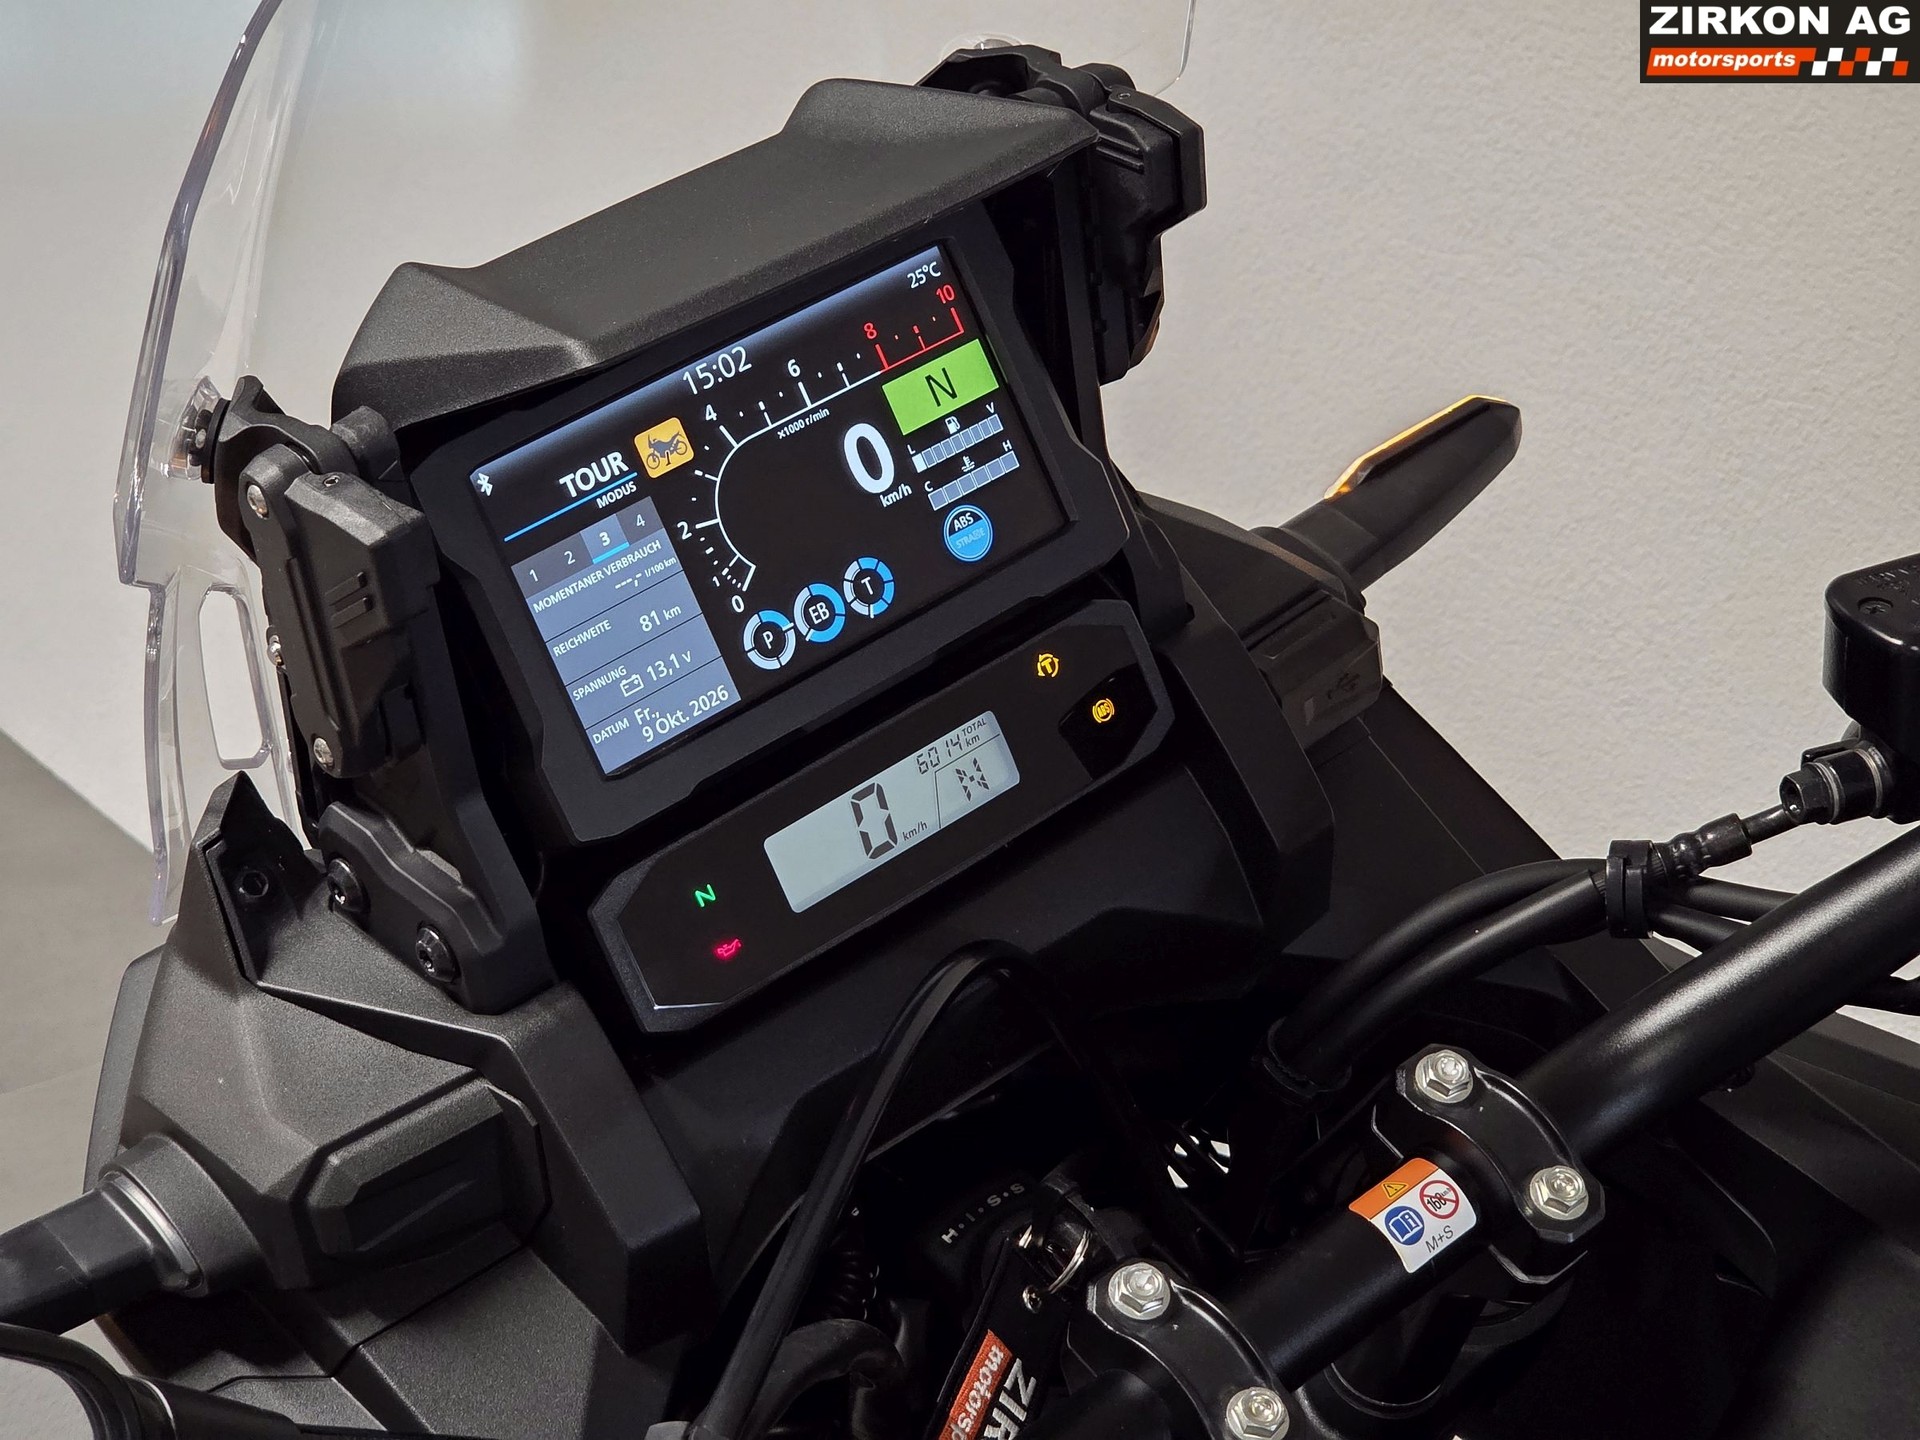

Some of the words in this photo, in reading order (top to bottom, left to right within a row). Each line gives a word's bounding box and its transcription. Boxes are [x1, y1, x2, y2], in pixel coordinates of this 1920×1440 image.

[907, 261, 941, 289] 25°C
[936, 284, 956, 304] 10
[863, 322, 877, 340] 8
[682, 346, 752, 395] 15:02
[787, 358, 801, 378] 6
[924, 367, 958, 407] N
[704, 404, 717, 422] 4
[803, 408, 830, 427] r/min
[985, 402, 995, 414] V
[907, 444, 916, 455] L
[1002, 440, 1012, 451] H
[843, 423, 895, 494] 0
[558, 451, 629, 497] TOUR
[595, 481, 638, 509] MODUS
[879, 483, 912, 508] km/h
[924, 481, 934, 493] C
[636, 514, 646, 528] 4
[677, 521, 693, 540] 2
[953, 512, 974, 532] ABS
[599, 531, 611, 547] 3
[564, 551, 576, 565] 2
[663, 556, 677, 568] km
[529, 568, 539, 582] 1
[533, 569, 605, 614] MOMENTANER
[603, 539, 662, 576] VERBRAUCH
[712, 576, 721, 588] 1
[861, 576, 875, 595] T
[731, 595, 745, 613] 0
[808, 601, 830, 625] EB
[639, 610, 661, 632] 81
[663, 605, 682, 621] km
[553, 619, 612, 657] REICHWEITE
[762, 630, 774, 650] P
[646, 652, 681, 683] 13,1
[572, 665, 628, 701] SPANNUNG
[633, 705, 661, 726] Fr.,
[642, 725, 654, 743] 9
[655, 710, 690, 737] Okt.
[688, 684, 729, 717] 2026
[592, 717, 630, 745] DATUM
[961, 717, 987, 737] TOTAL
[916, 733, 963, 775] 6014
[965, 734, 980, 748] km
[850, 782, 898, 860] 0
[903, 820, 928, 842] km/h
[694, 884, 716, 908] N
[1425, 1225, 1454, 1253] M+S
